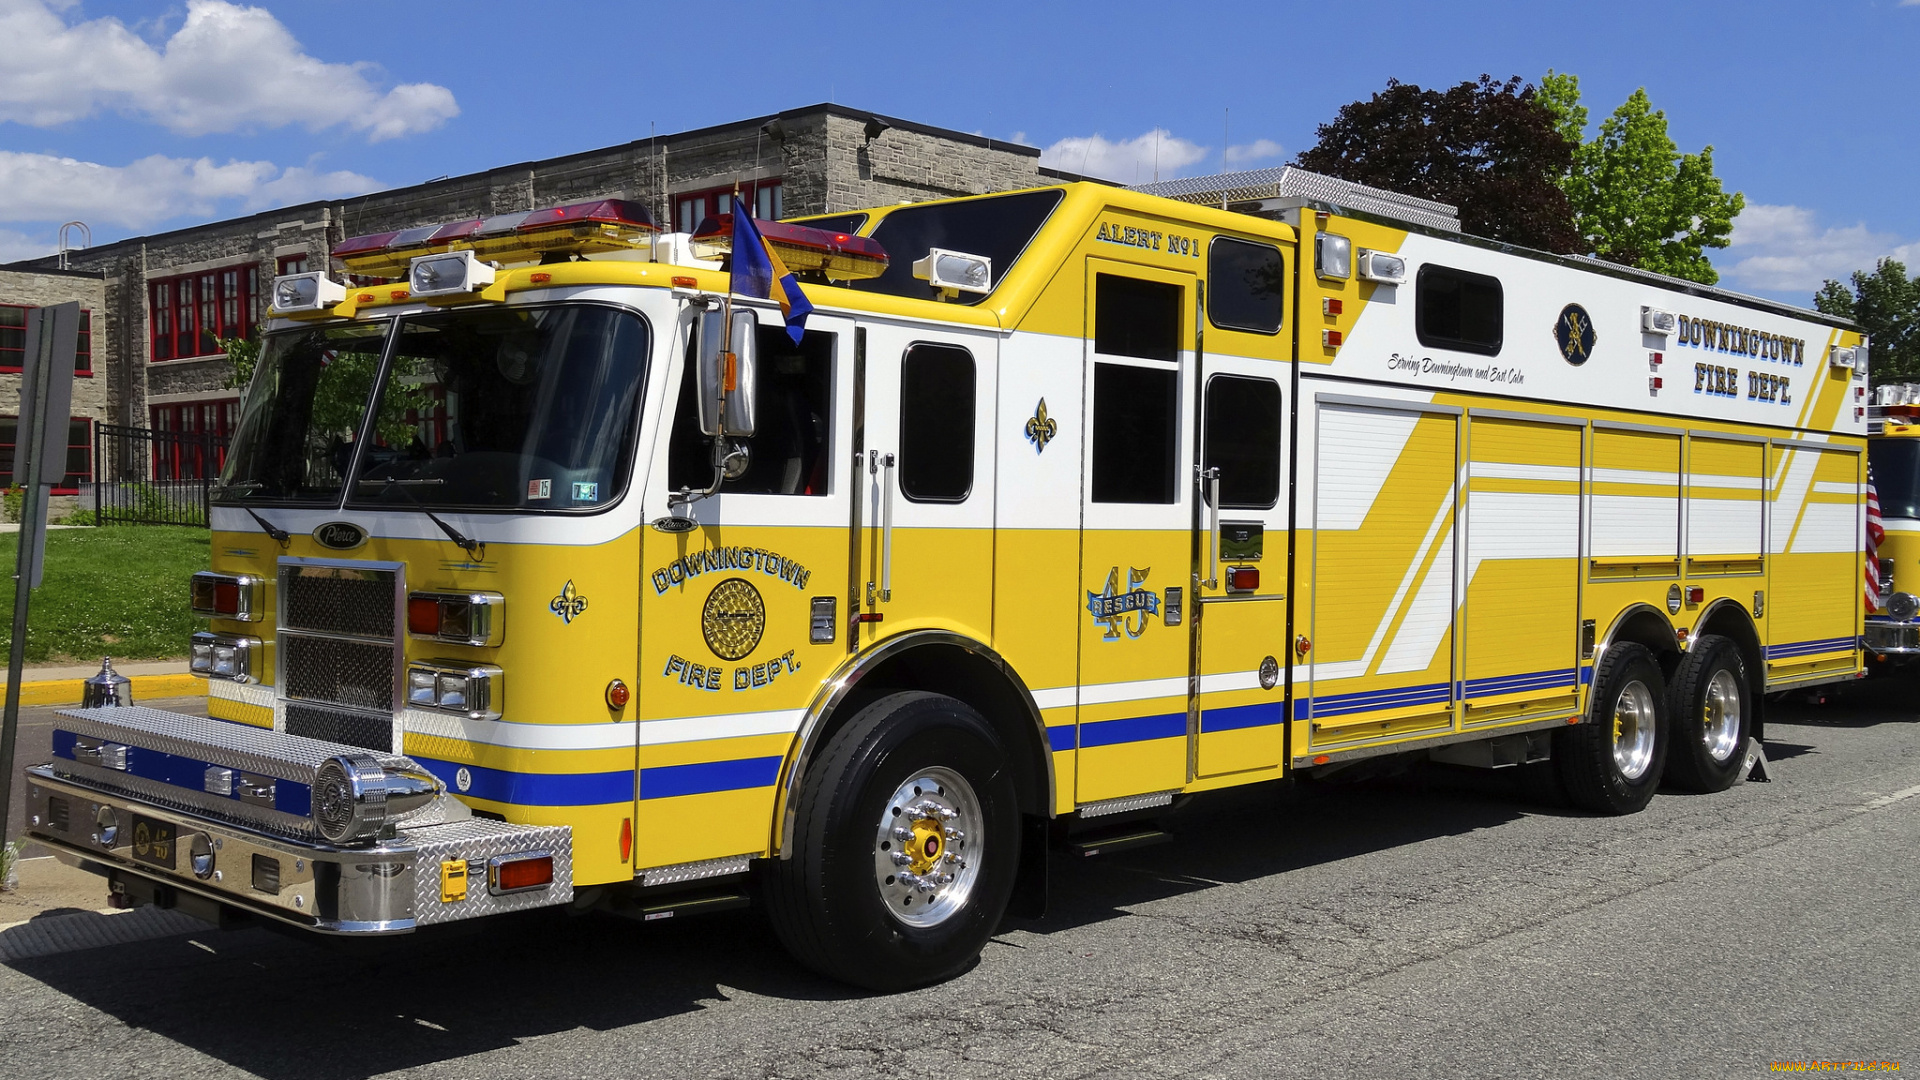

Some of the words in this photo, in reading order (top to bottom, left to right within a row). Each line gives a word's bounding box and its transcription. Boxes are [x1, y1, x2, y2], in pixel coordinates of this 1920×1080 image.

[1096, 222, 1162, 251] ALERT
[1678, 314, 1805, 367] DOWNINGTOWN
[1387, 353, 1421, 377] Serving
[1421, 357, 1474, 382] Downingtown
[1474, 364, 1491, 381] and
[1489, 366, 1507, 383] East
[1694, 362, 1738, 398] FIRE
[1748, 371, 1792, 406] DEPT.
[540, 480, 549, 497] 15
[325, 525, 356, 543] Pierce
[660, 519, 690, 529] Lance
[651, 546, 812, 595] DOWNINGTOWN
[1092, 592, 1155, 615] RESCUE
[1095, 565, 1151, 641] 45
[663, 654, 723, 692] FIRE
[732, 649, 802, 692] DEPT.
